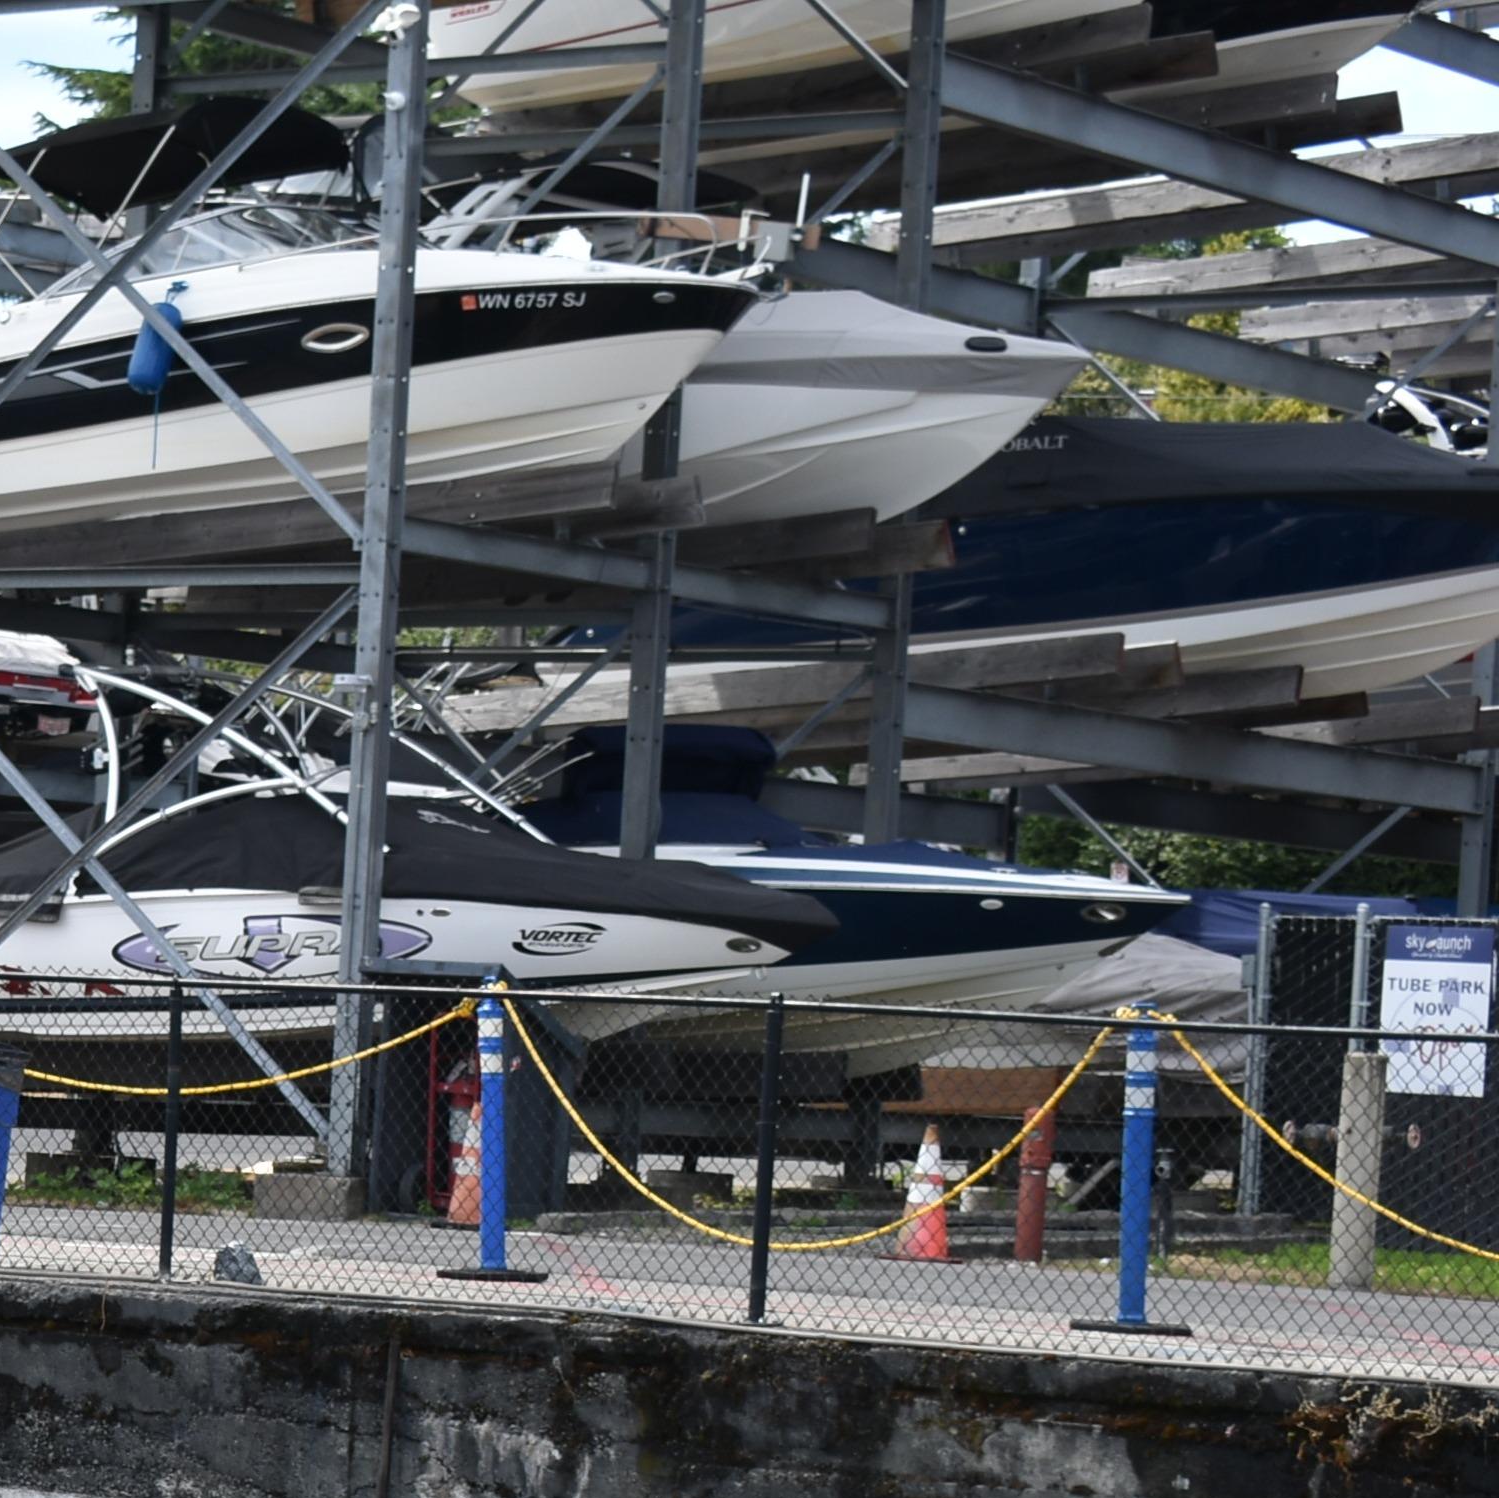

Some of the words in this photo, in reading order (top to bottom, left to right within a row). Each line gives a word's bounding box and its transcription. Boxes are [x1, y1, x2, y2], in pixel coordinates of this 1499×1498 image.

[478, 293, 510, 309] WN
[514, 291, 557, 309] 6757
[561, 290, 587, 308] SJ
[1001, 434, 1070, 453] OBALT
[518, 929, 603, 944] VORTEC
[155, 929, 343, 963] SUPR
[1388, 977, 1433, 993] TUBE
[1438, 978, 1486, 995] PARK
[1413, 1002, 1453, 1017] NOW
